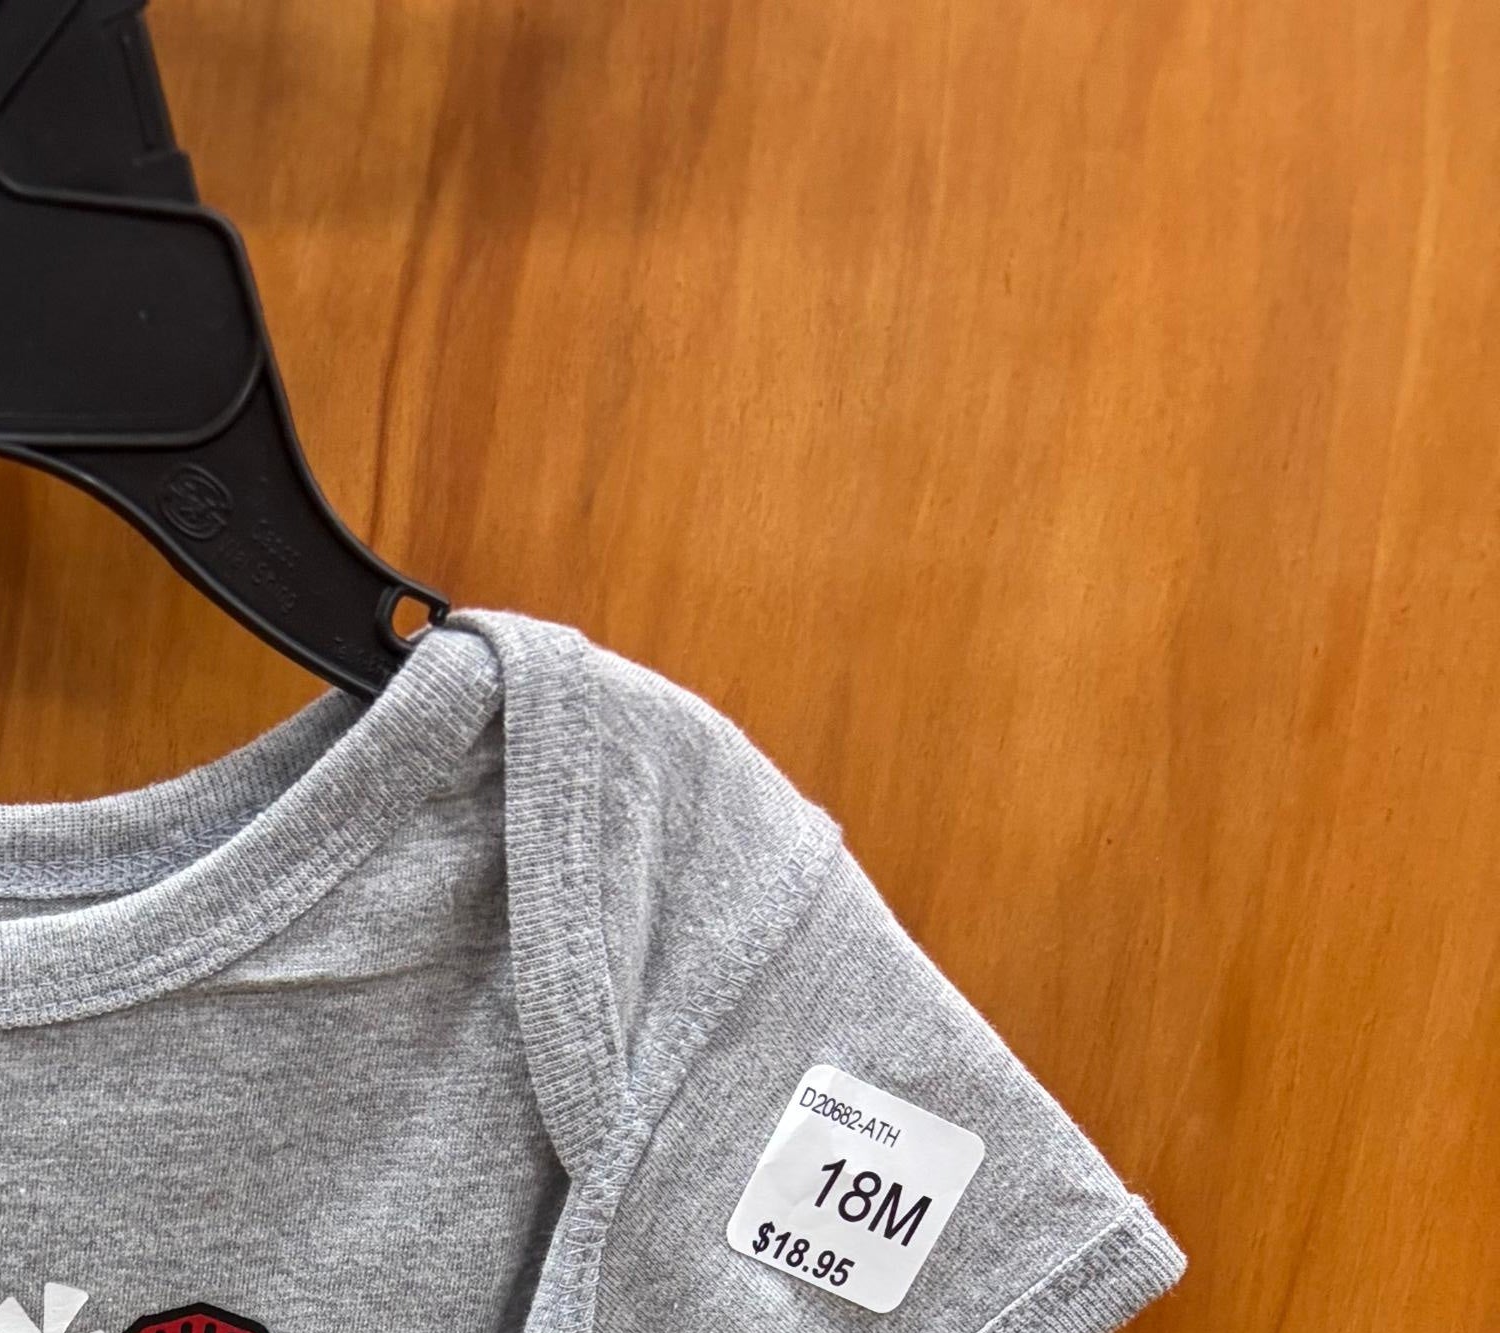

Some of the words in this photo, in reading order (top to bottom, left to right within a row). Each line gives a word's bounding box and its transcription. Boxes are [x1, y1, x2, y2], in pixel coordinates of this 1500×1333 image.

[799, 1087, 900, 1148] D20682-ATH
[814, 1158, 933, 1247] 18M
[752, 1221, 855, 1286] $18.95
